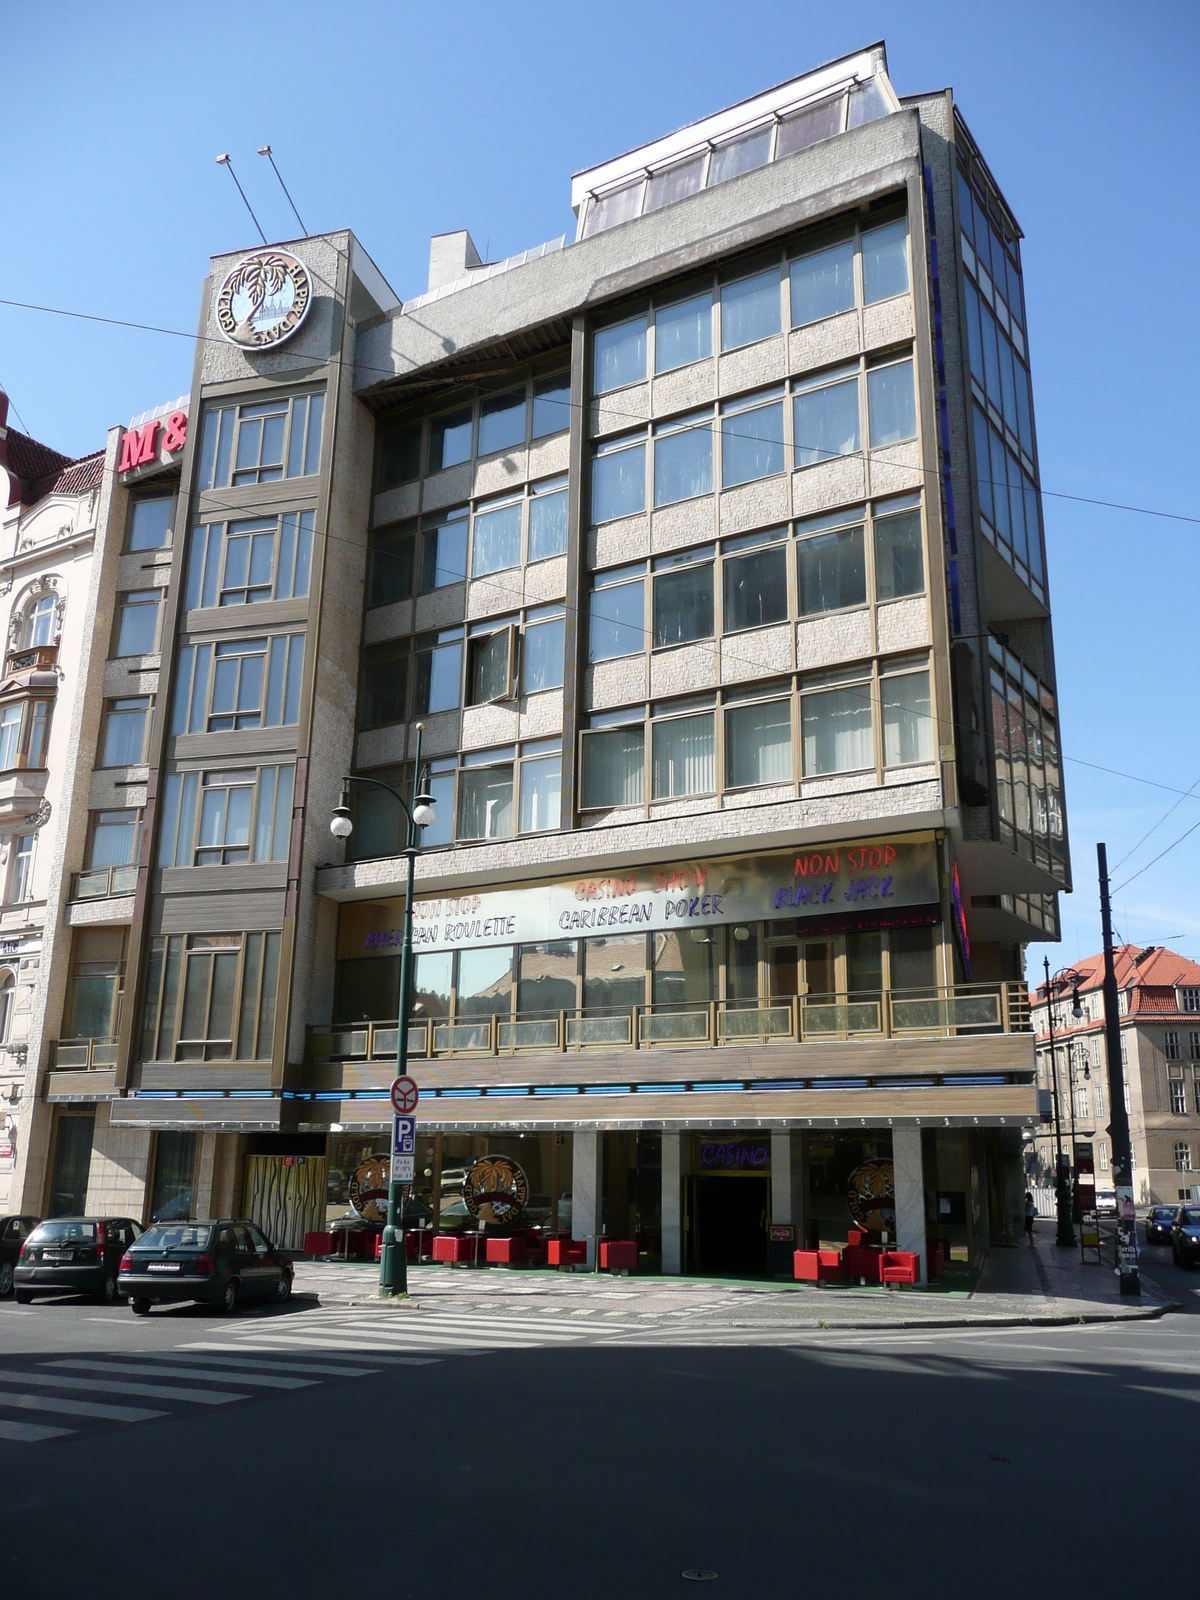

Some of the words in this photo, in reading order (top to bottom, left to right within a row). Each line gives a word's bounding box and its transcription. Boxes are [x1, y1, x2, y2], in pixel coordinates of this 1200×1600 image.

[289, 261, 310, 320] HAPPY
[219, 287, 236, 333] GOLD
[261, 315, 295, 344] DAY
[793, 851, 841, 878] NON
[847, 845, 897, 871] STOP
[574, 876, 637, 902] CASINO
[653, 868, 708, 894] SHOW
[774, 882, 834, 909] BLACK
[843, 875, 894, 901] JACK
[445, 895, 481, 917] STOP
[558, 902, 653, 930] CARIBBEAN
[664, 894, 725, 920] POKER
[365, 924, 438, 950] AMERCAN
[444, 915, 516, 942] ROULETTE
[398, 1120, 411, 1143] P
[702, 1143, 768, 1166] CASINO
[351, 1182, 363, 1211] GOLD
[464, 1184, 478, 1213] GOLD
[513, 1170, 526, 1206] HAPPY
[502, 1206, 520, 1223] DAY
[848, 1190, 864, 1220] GOLD
